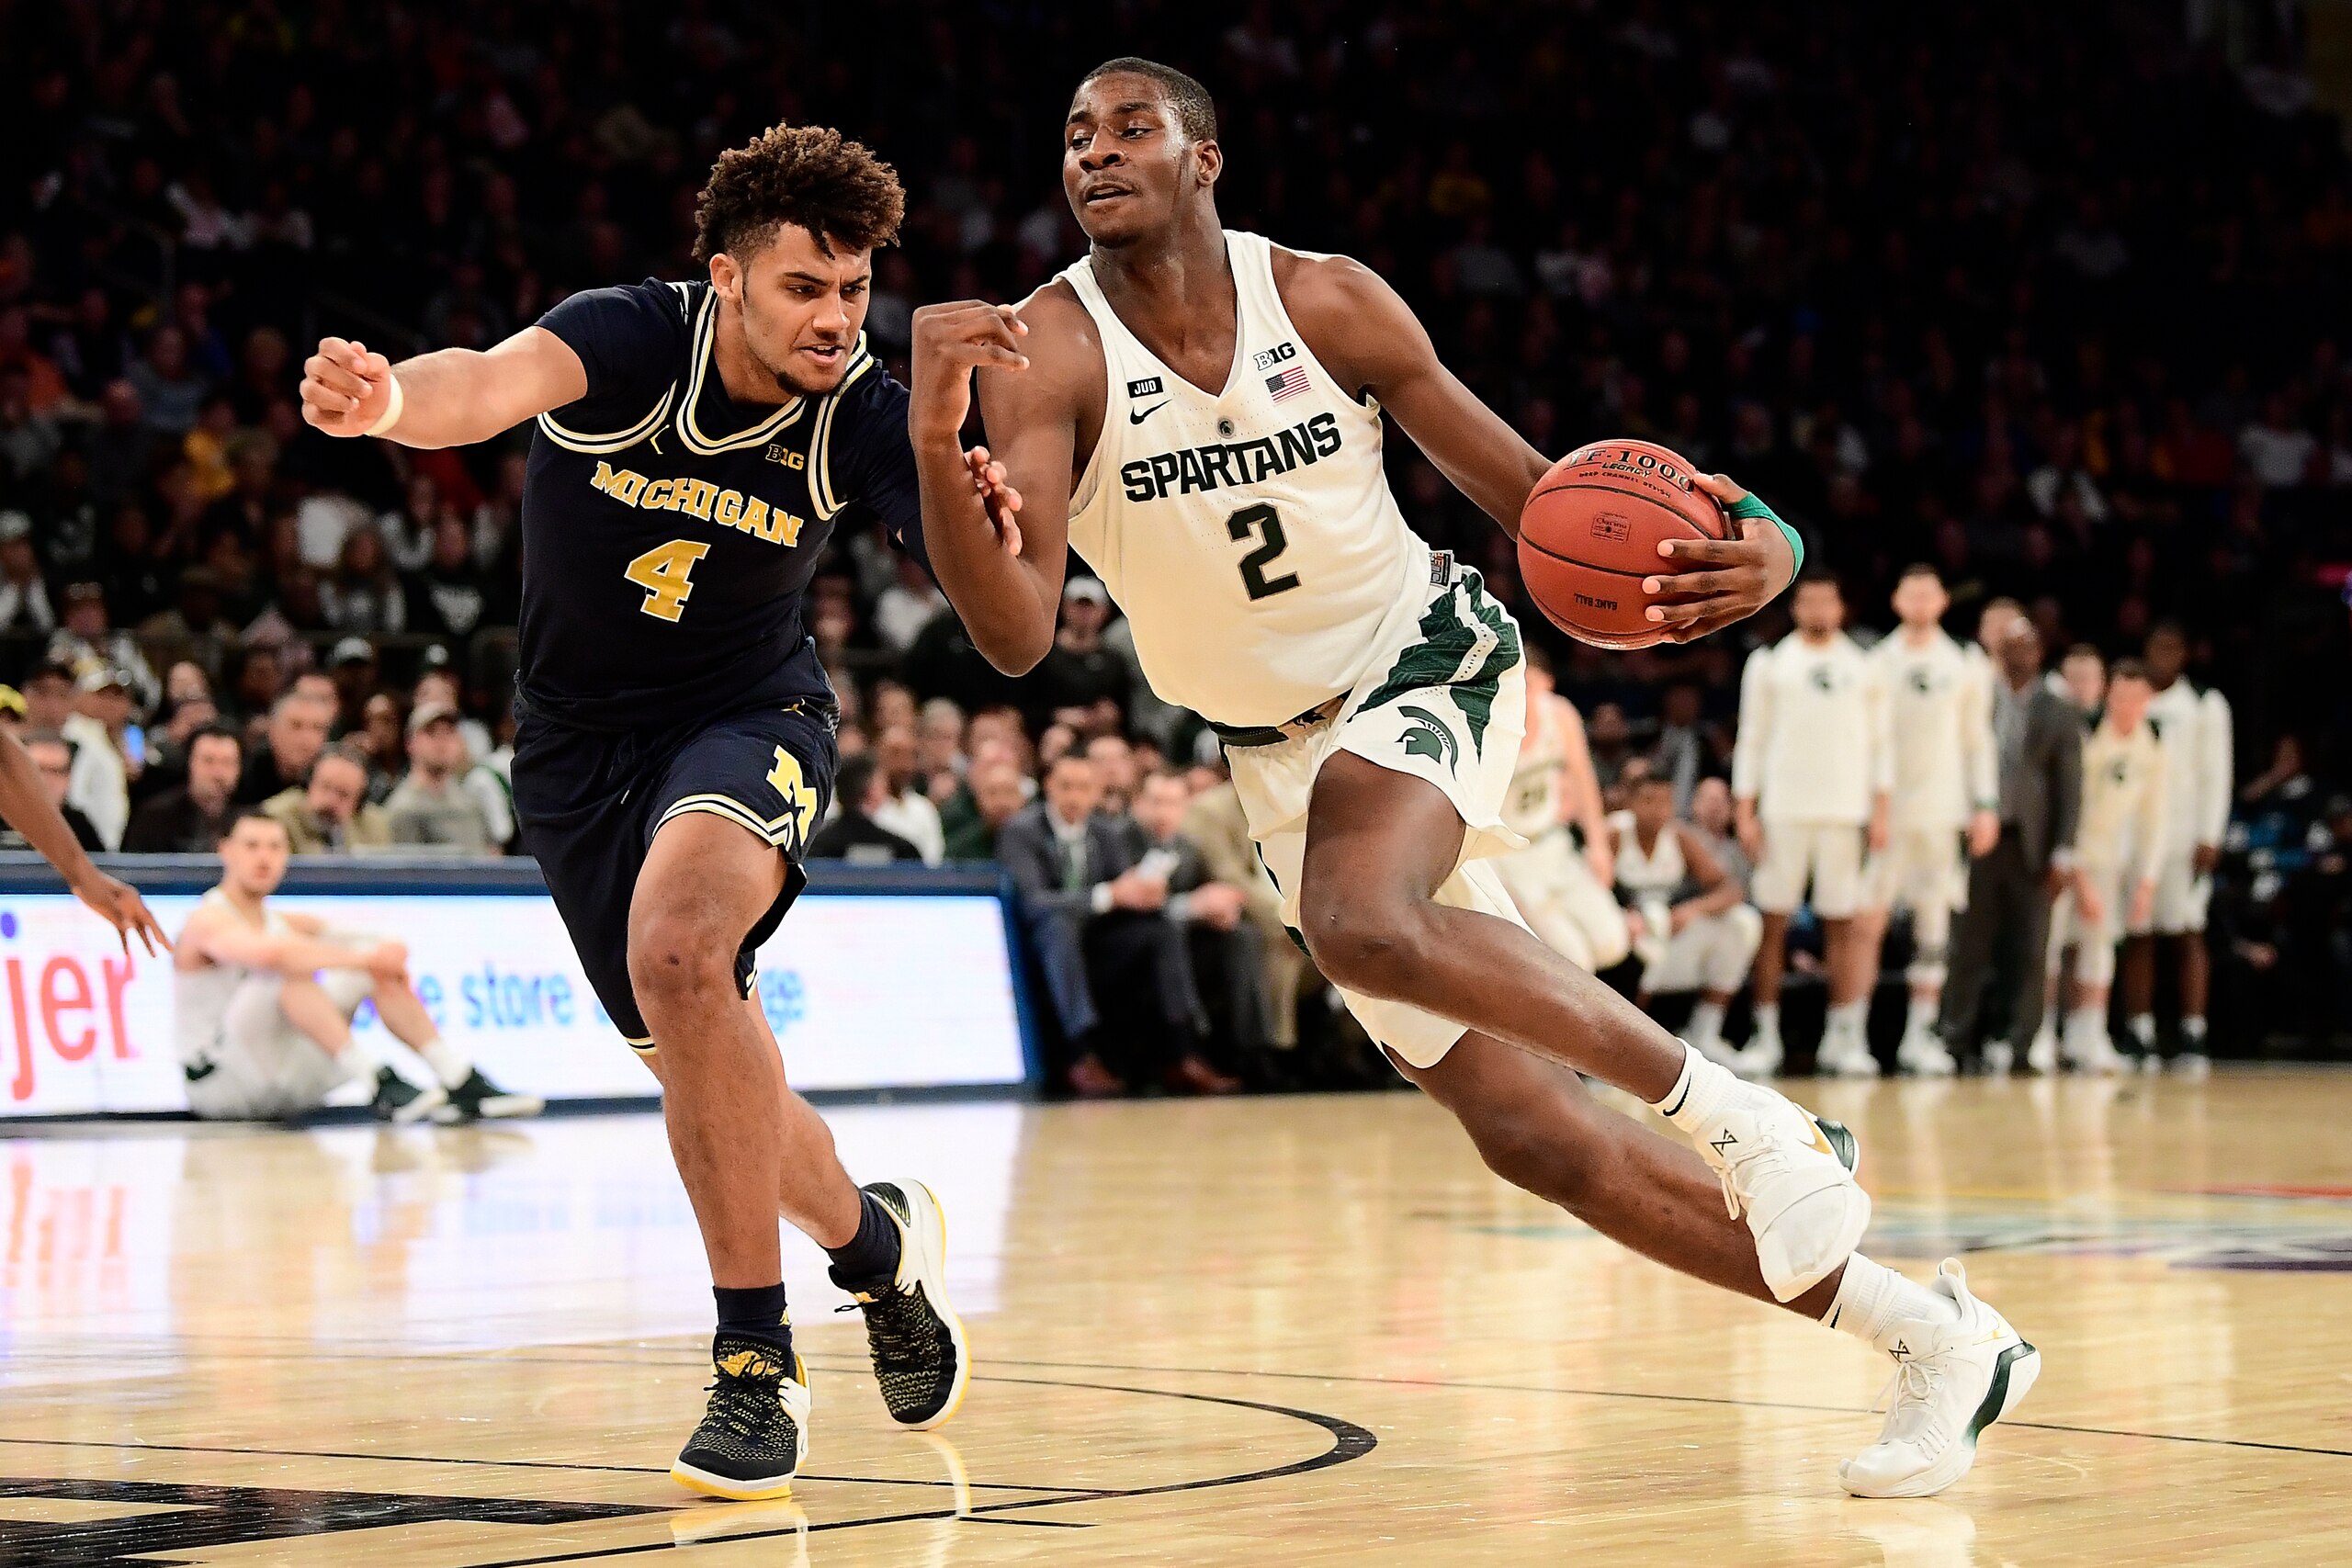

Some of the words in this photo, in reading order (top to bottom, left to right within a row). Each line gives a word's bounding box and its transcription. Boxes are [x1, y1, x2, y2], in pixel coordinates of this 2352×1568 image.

[1134, 379, 1157, 396] JUD
[1121, 412, 1342, 502] SPARTANS
[1601, 461, 1652, 479] LEGACY
[590, 460, 804, 547] MICHIGAN
[624, 538, 711, 623] 4
[1225, 501, 1302, 602] 2
[1574, 592, 1594, 607] BALL
[1594, 598, 1618, 611] GAME
[765, 744, 818, 847] M
[460, 960, 573, 1030] store
